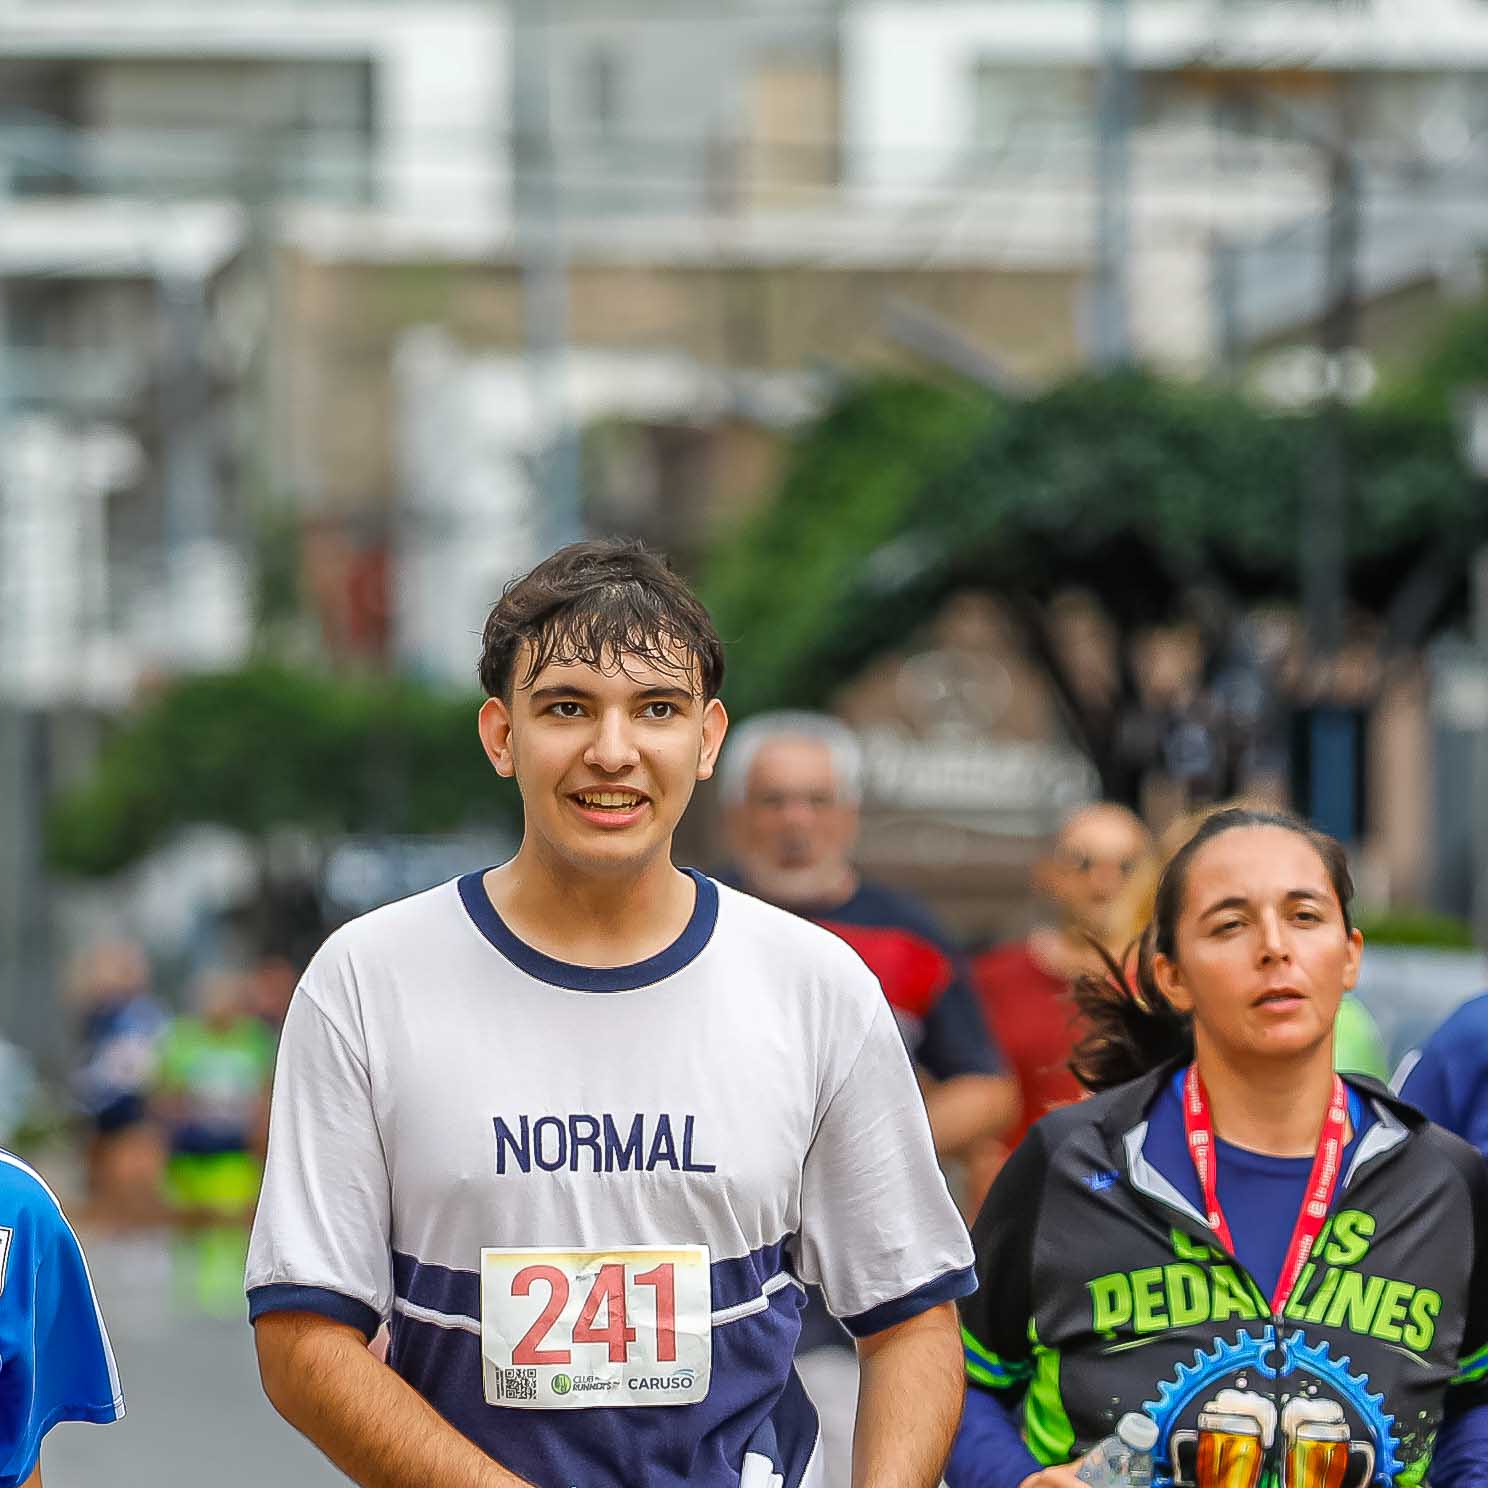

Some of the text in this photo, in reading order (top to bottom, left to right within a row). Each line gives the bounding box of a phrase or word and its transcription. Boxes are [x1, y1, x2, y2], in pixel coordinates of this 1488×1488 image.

[493, 1113, 716, 1175] NORMAL
[1170, 1208, 1376, 1266] LS
[511, 1263, 676, 1365] 241
[628, 1377, 693, 1390] CARUSO
